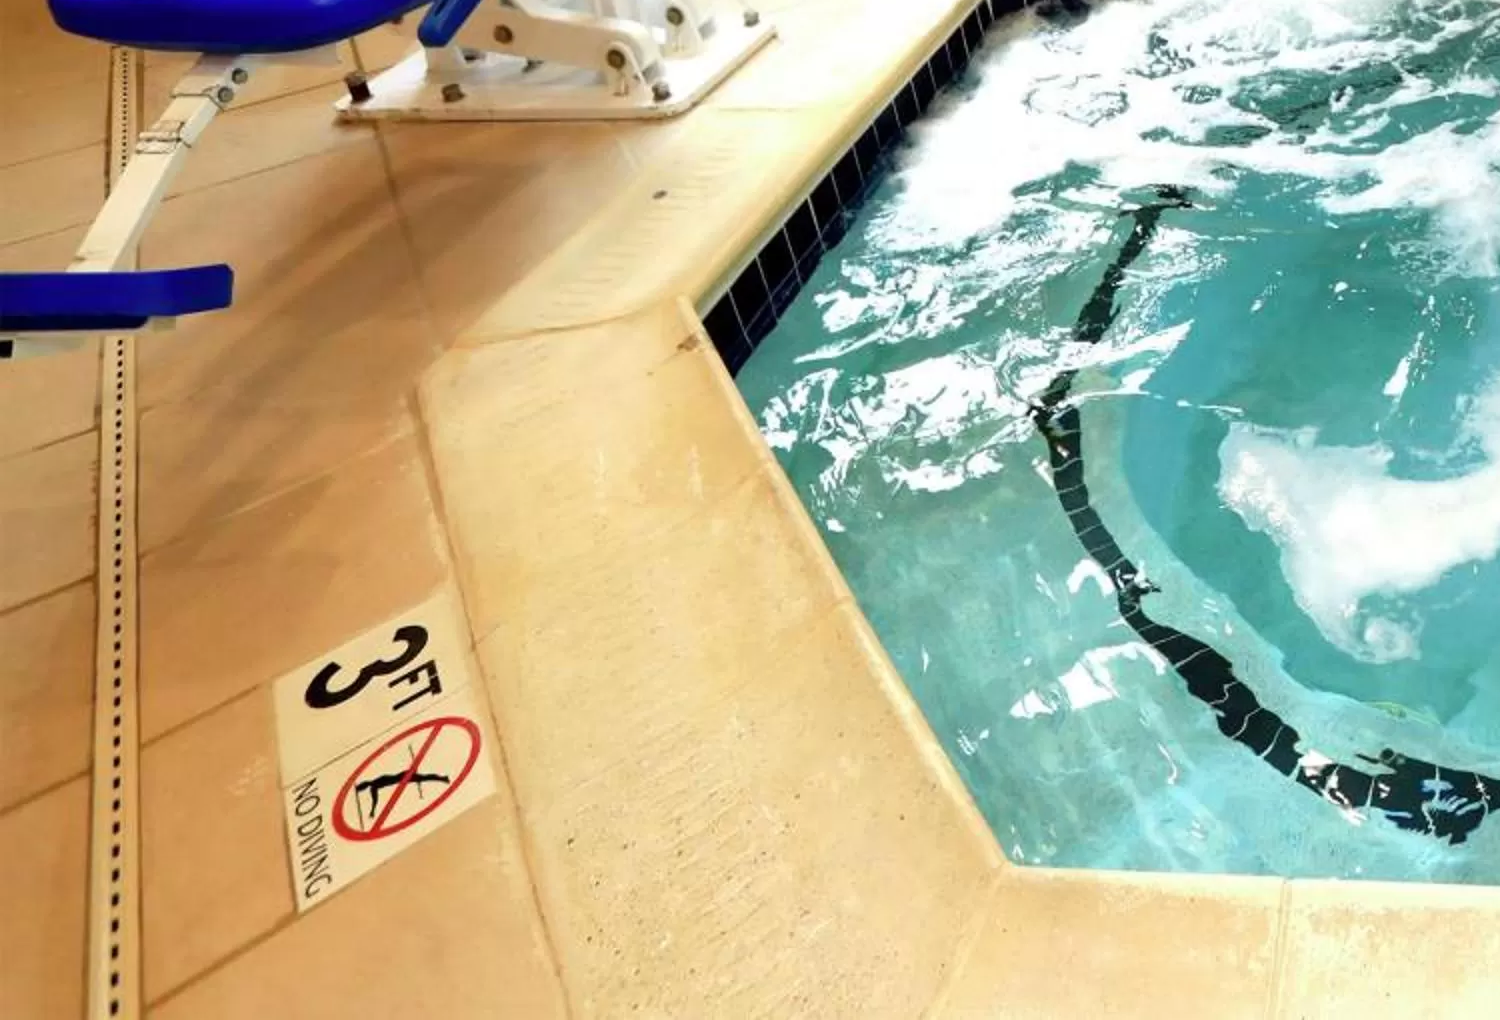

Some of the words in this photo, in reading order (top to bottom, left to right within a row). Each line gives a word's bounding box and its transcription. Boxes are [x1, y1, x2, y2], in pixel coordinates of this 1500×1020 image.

[304, 625, 429, 709] 3
[387, 659, 443, 712] FT
[291, 777, 321, 817] NO
[297, 817, 333, 900] DIVING
